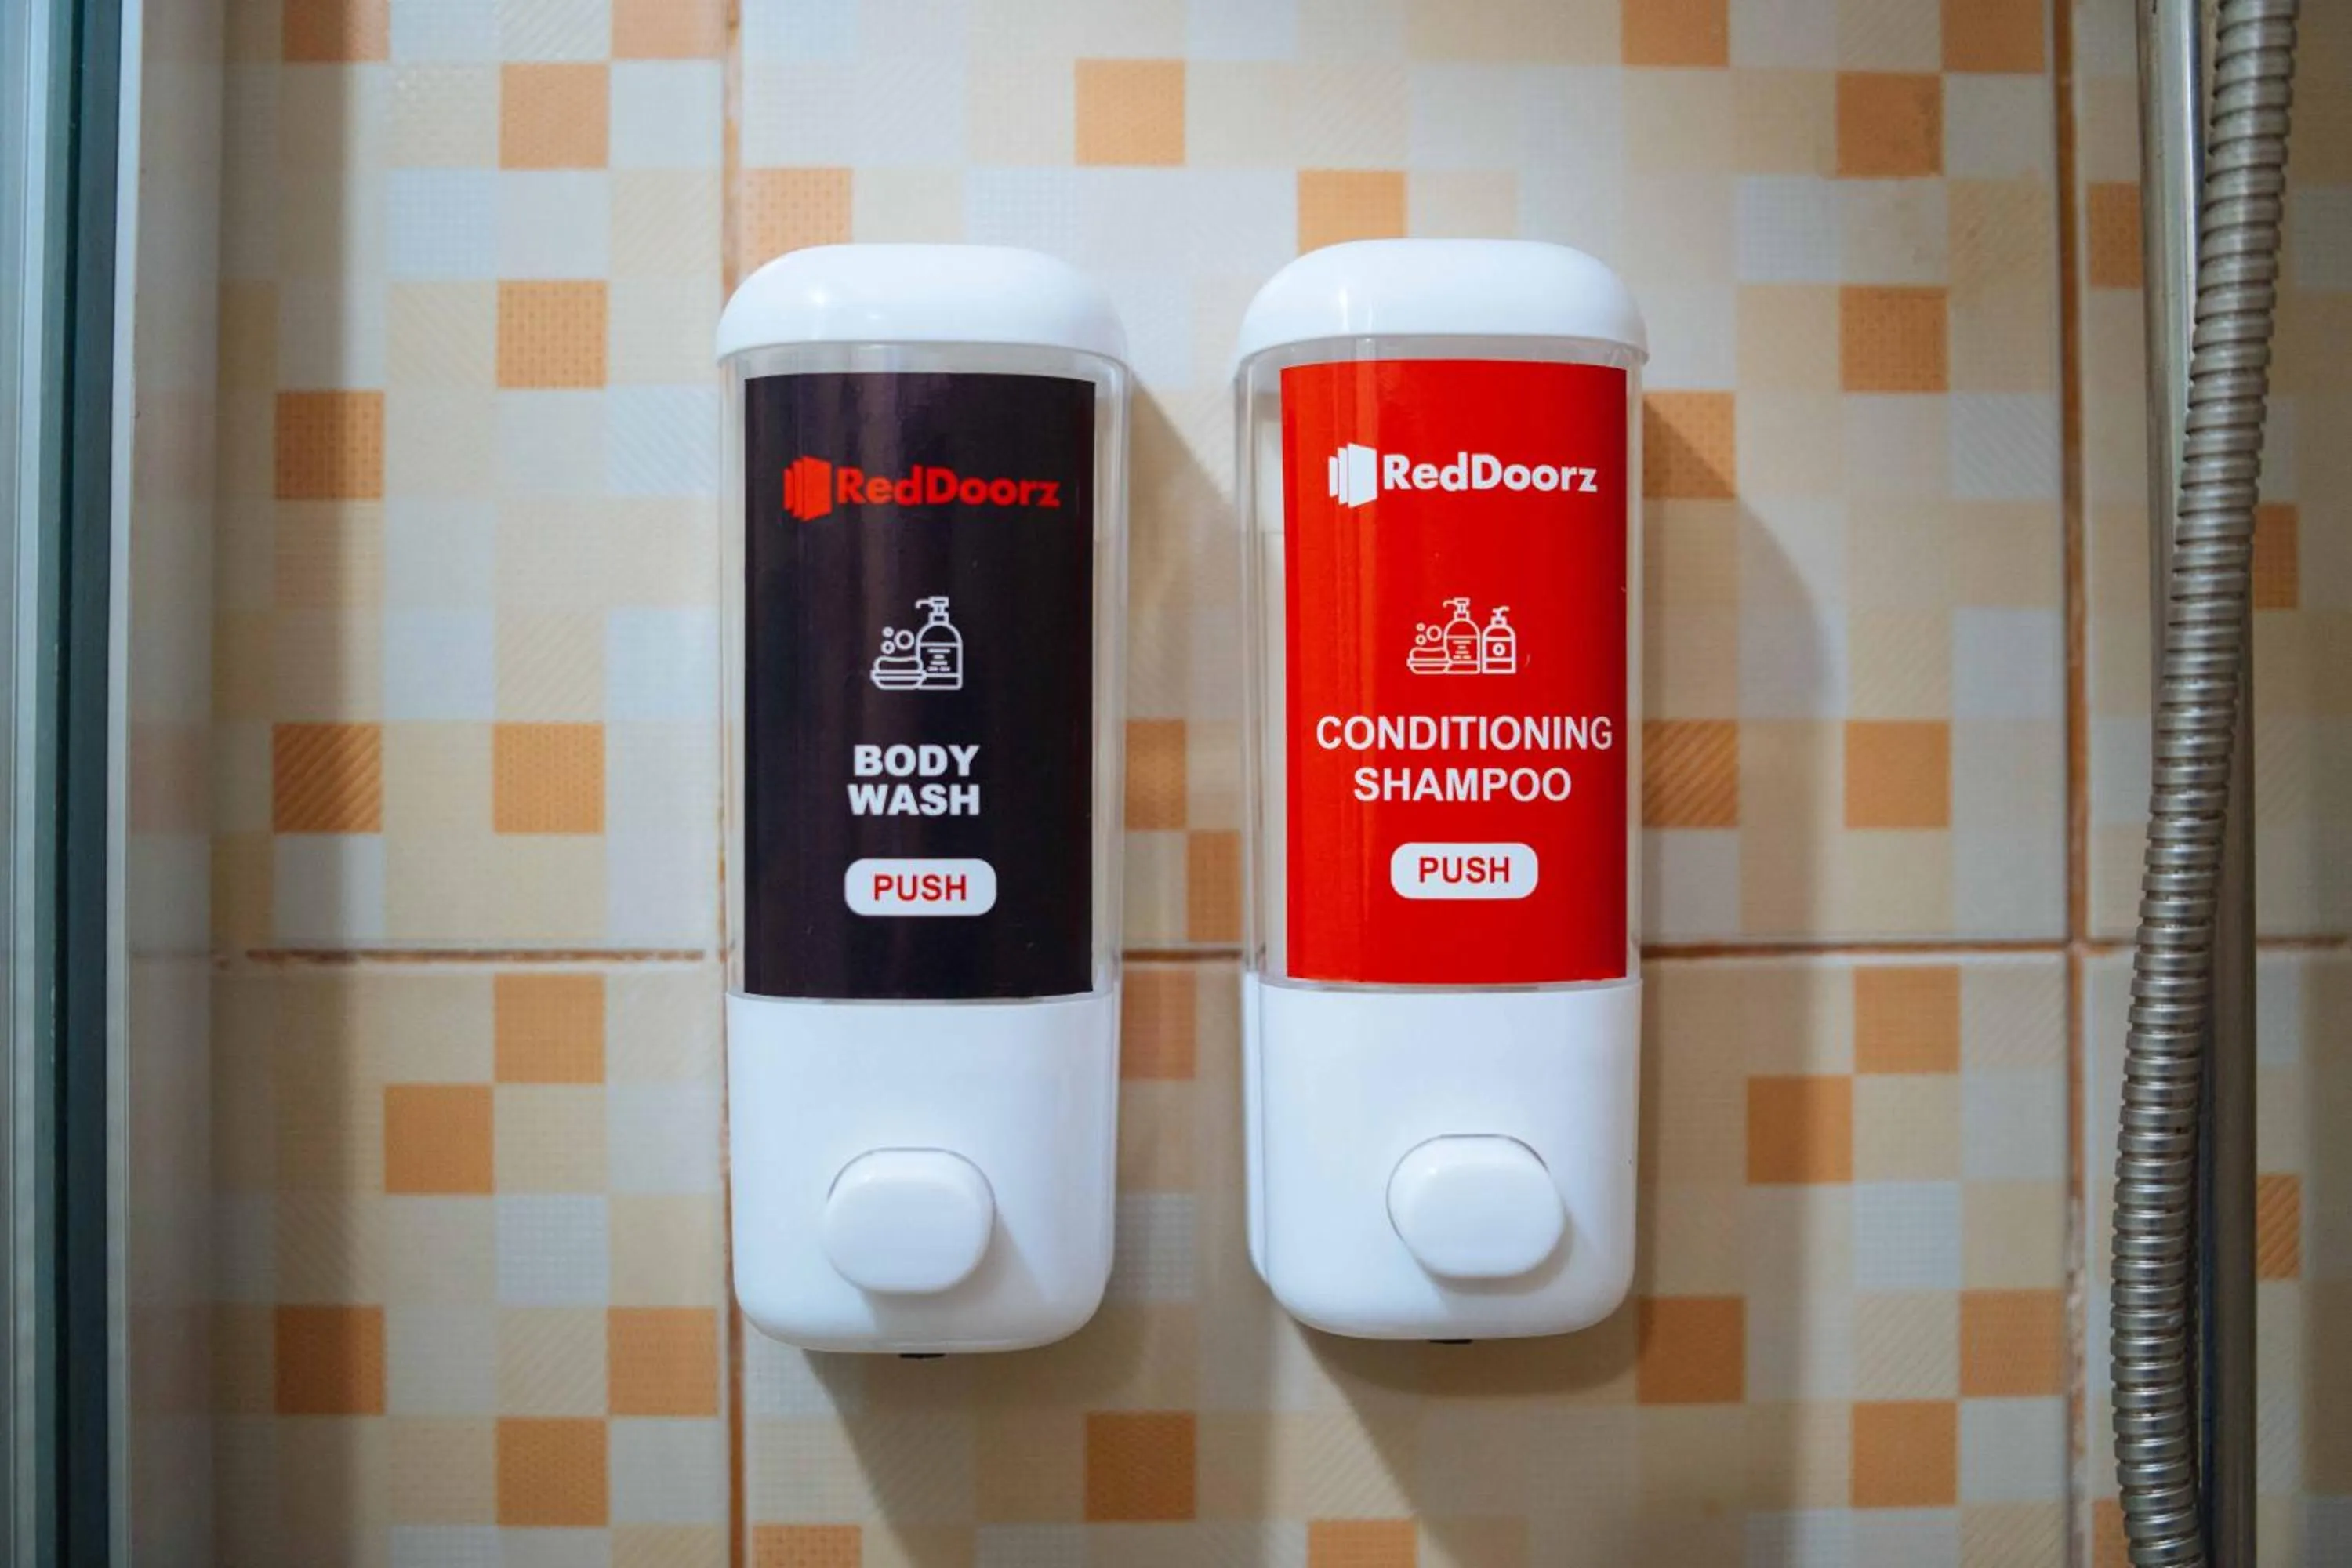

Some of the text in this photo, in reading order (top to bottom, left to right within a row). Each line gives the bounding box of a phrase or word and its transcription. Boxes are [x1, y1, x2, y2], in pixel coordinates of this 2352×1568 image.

[836, 464, 1061, 508] RedDoorz
[1382, 451, 1598, 492] RedDoorz
[1316, 715, 1613, 750] CONDITIONING
[854, 744, 980, 777] BODY
[848, 783, 980, 816] WASH
[1354, 767, 1572, 802] SHAMPOO
[1418, 856, 1511, 884] PUSH
[873, 873, 967, 902] PUSH
